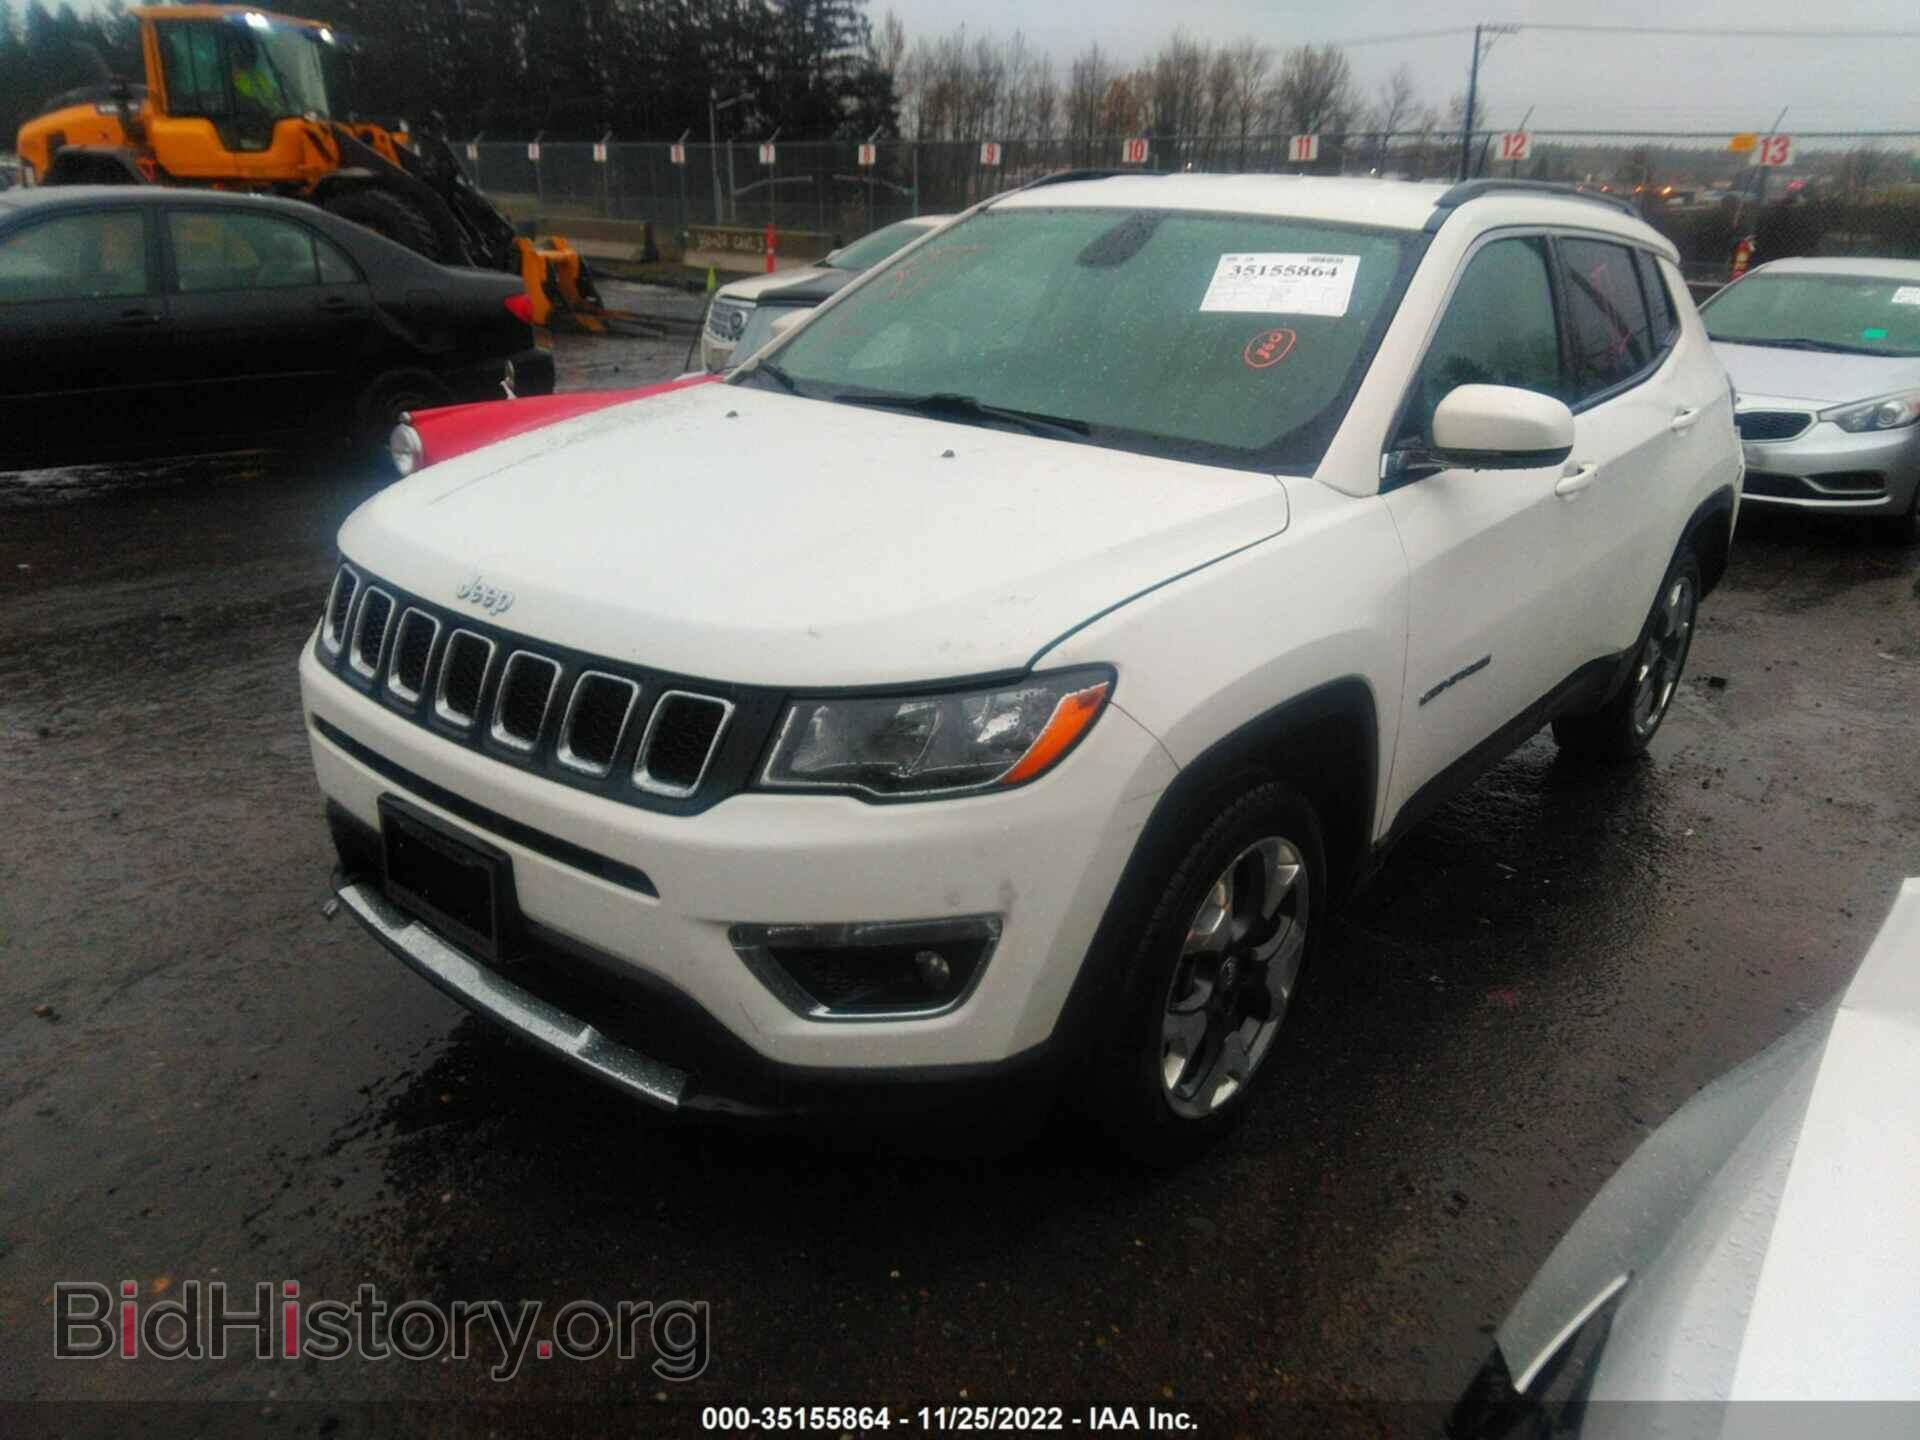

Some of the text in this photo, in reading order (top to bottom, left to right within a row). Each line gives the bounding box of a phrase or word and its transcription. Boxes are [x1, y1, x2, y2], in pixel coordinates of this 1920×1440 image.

[1127, 141, 1145, 162] 10
[1296, 136, 1312, 160] 11
[1502, 134, 1525, 159] 12
[1759, 134, 1790, 164] 13
[1229, 264, 1339, 278] 35155864
[456, 575, 514, 616] Jeep
